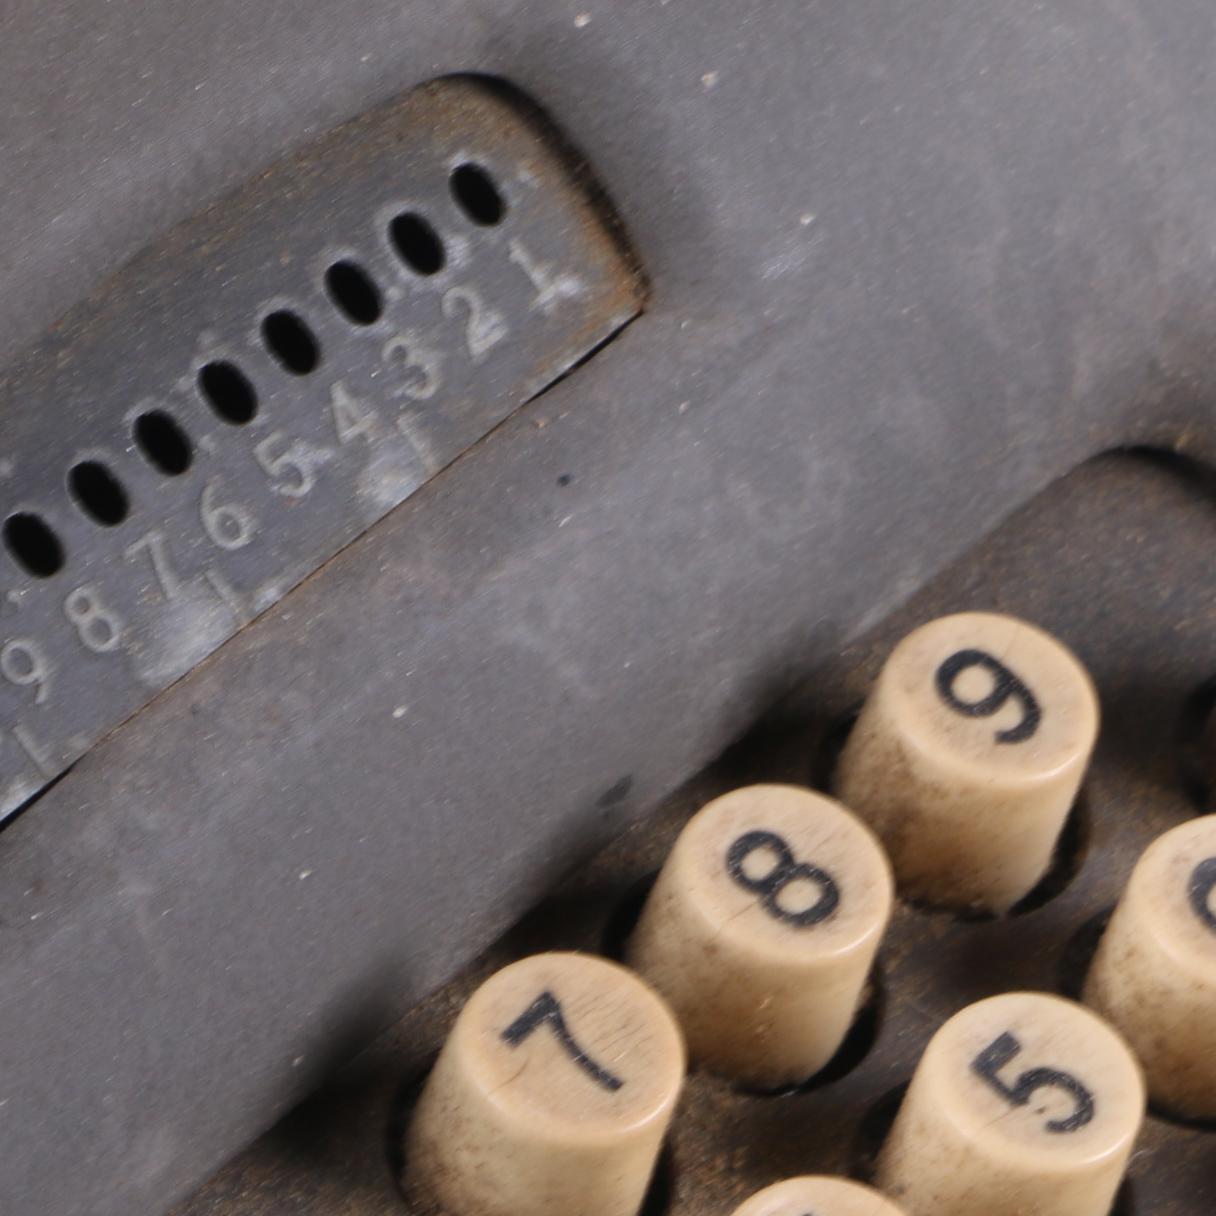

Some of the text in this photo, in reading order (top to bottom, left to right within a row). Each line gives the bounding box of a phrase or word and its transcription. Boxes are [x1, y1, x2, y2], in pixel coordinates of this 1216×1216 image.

[0, 638, 51, 704] 9
[64, 588, 119, 653] 8
[124, 528, 181, 601] 7
[201, 483, 257, 550] 6
[253, 431, 318, 499] 5
[330, 380, 378, 445] 4
[381, 335, 440, 400] 3
[441, 285, 507, 357] 2
[934, 648, 1042, 746] 9
[724, 829, 840, 930] 8
[502, 989, 625, 1093] 7
[969, 1030, 1096, 1135] 5
